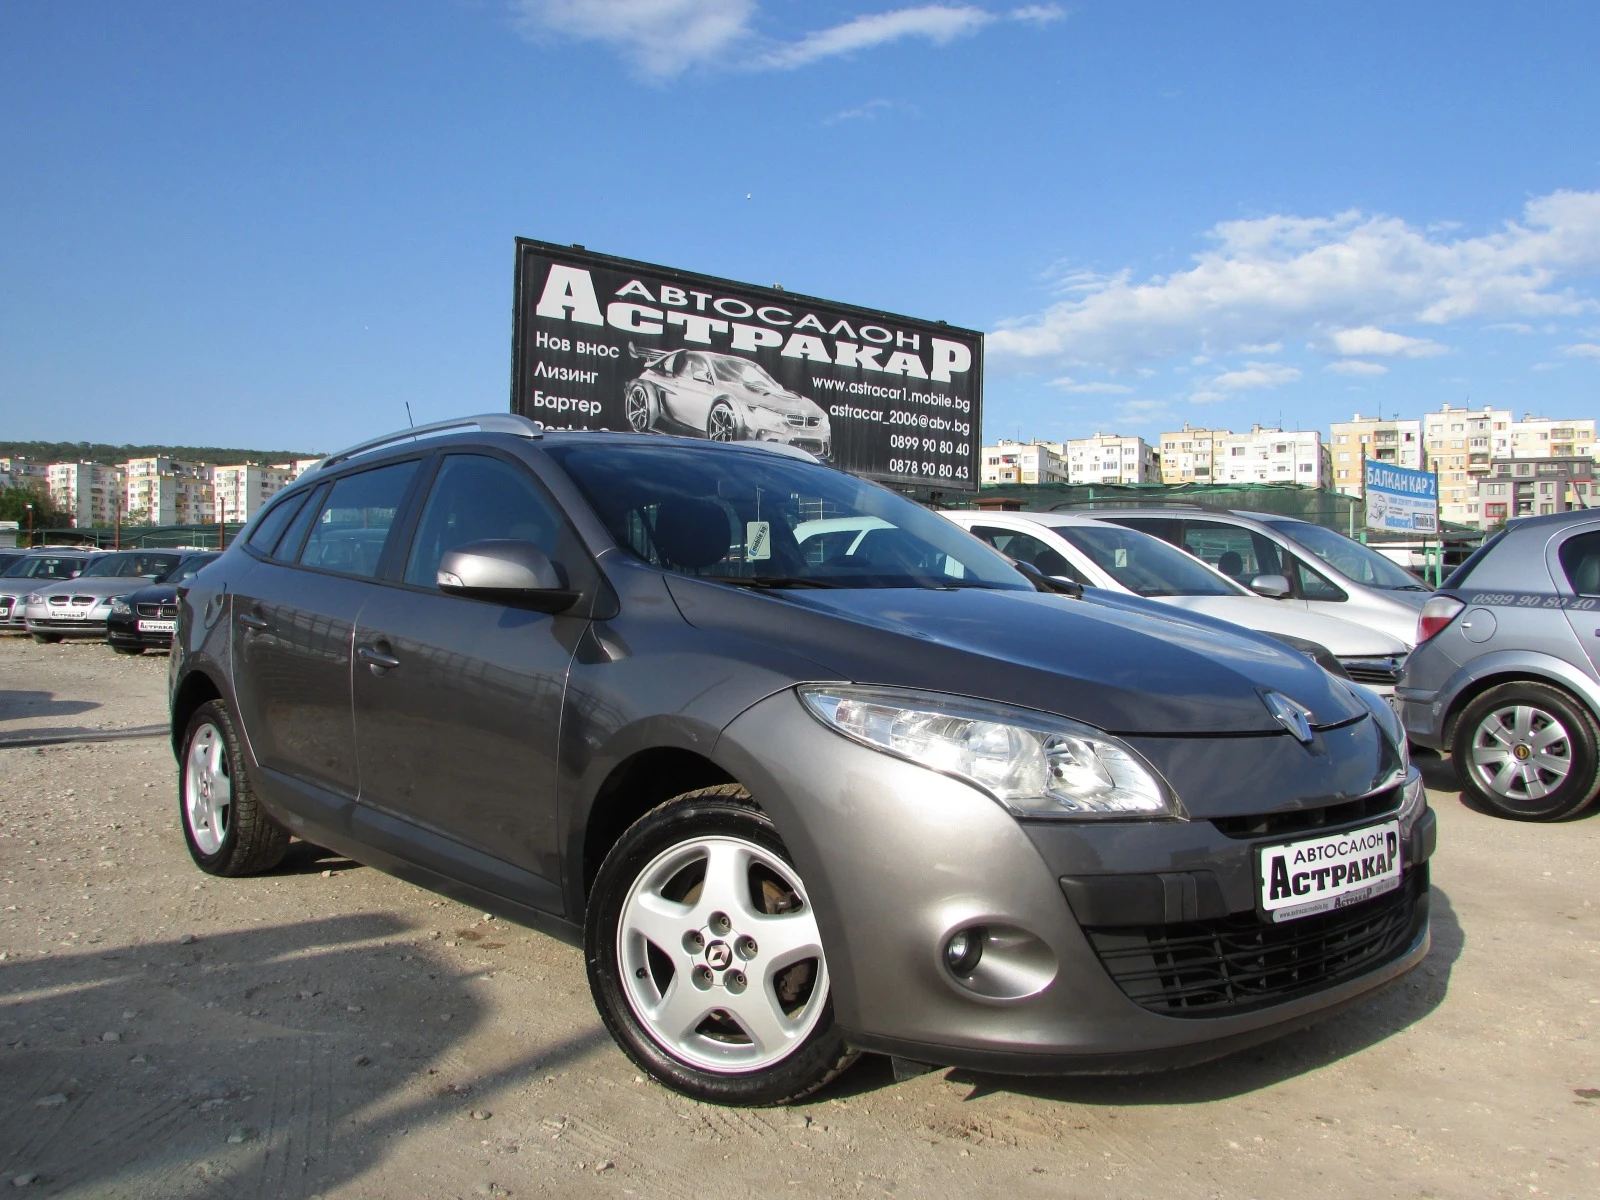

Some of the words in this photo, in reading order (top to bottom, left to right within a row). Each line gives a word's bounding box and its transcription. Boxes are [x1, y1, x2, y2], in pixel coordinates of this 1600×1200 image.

[614, 279, 921, 350] АВТОСАЛОН
[535, 331, 572, 352] Нов
[576, 340, 620, 359] внос
[534, 361, 599, 384] Лизинг
[534, 390, 602, 416] Бартер
[811, 376, 970, 413] www.astracar1.mobile.bg
[829, 403, 970, 436] astracar_2006@abv.bg
[890, 435, 919, 450] 0899
[922, 439, 936, 452] 90
[939, 441, 953, 454] 80
[955, 443, 970, 456] 40
[889, 458, 918, 473] 0878
[922, 462, 936, 475] 90
[938, 464, 953, 477] 80
[955, 466, 969, 479] 43
[1367, 466, 1408, 491] БАЛКАН
[1409, 475, 1428, 494] КАР
[1429, 479, 1435, 495] 2
[1472, 593, 1515, 605] 0899
[1516, 595, 1540, 606] 90
[1543, 597, 1568, 608] 80
[1570, 598, 1596, 610] 40
[1293, 832, 1384, 865] АВТОСАЛОН
[1269, 831, 1397, 900] АСТРАКАР
